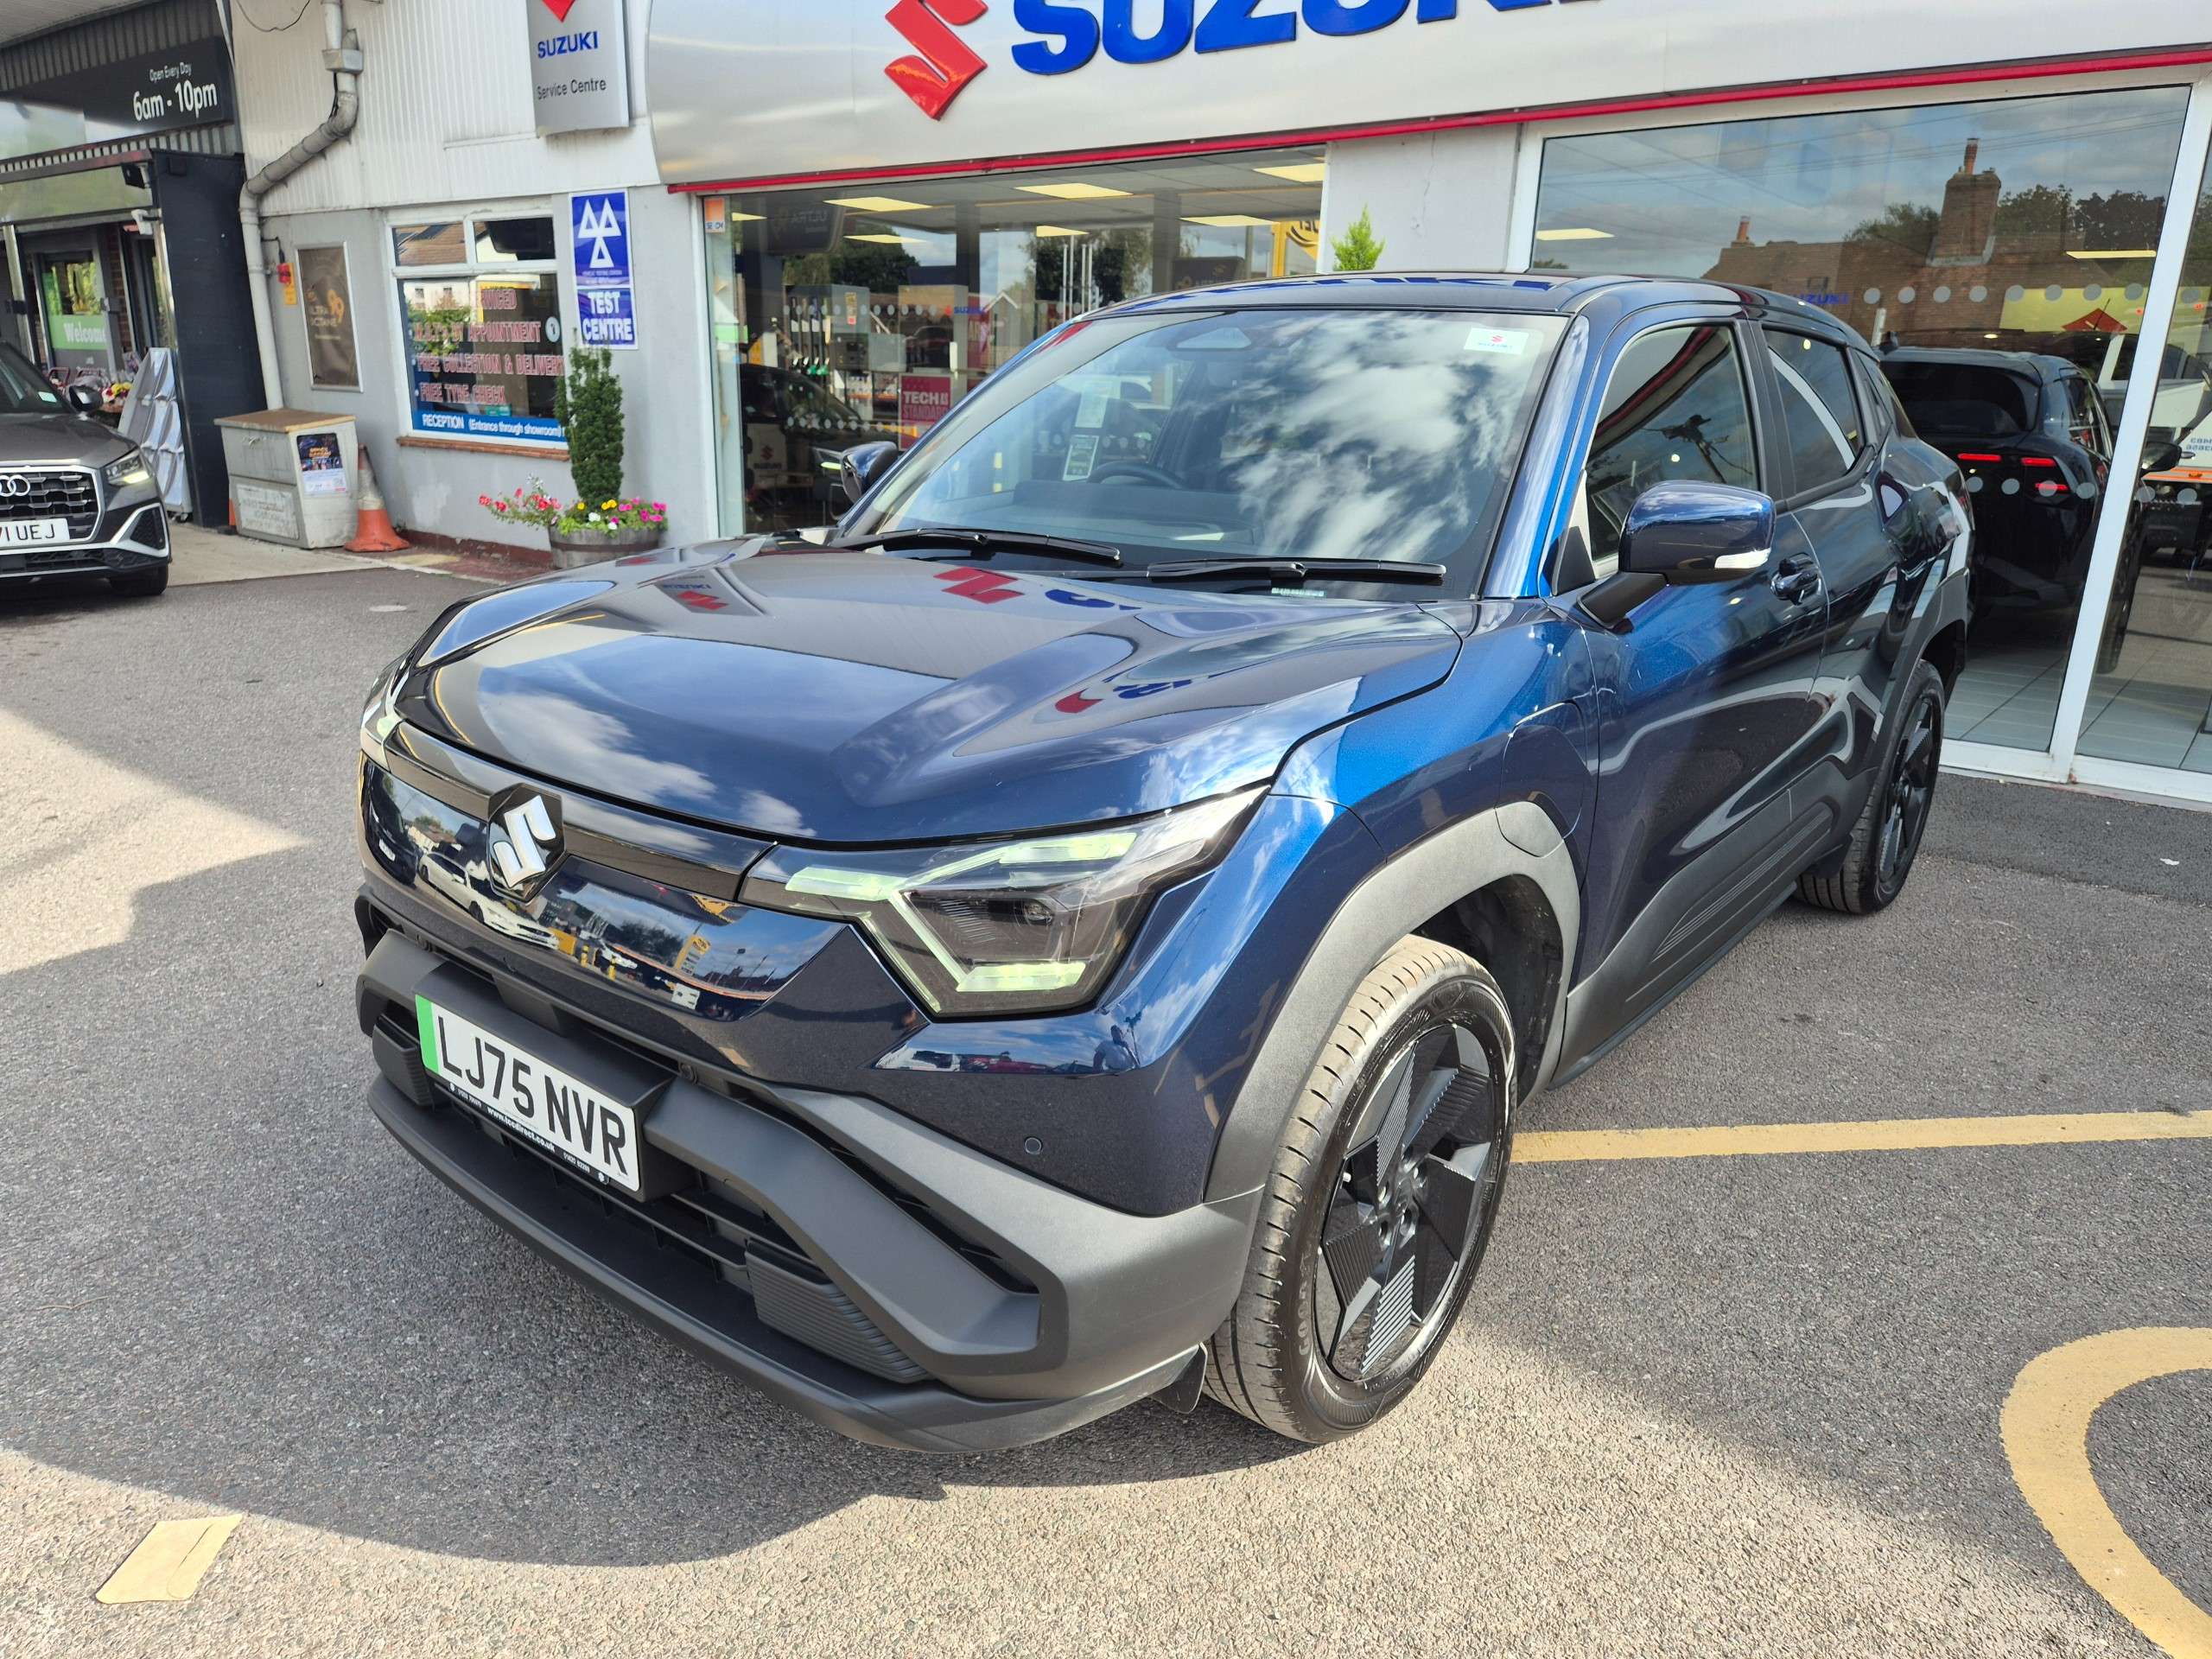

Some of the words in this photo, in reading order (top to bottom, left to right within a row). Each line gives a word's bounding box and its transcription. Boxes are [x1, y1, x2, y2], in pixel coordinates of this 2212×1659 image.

[537, 31, 598, 59] SUZUKI
[1012, 0, 1552, 76] SUZ
[149, 69, 165, 82] Open
[164, 65, 179, 79] Every
[180, 61, 192, 76] Day
[133, 91, 165, 121] 6am
[175, 79, 218, 118] 10pm
[537, 85, 568, 99] Service
[570, 79, 607, 93] Centre
[588, 291, 620, 315] TEST
[468, 321, 542, 342] APPOINTMENT
[582, 318, 632, 340] CENTRE
[418, 353, 441, 372] FREE
[442, 353, 502, 374] COLLECTION
[505, 354, 514, 375] &
[420, 382, 443, 403] FREE
[444, 384, 470, 404] TYRE
[472, 385, 507, 405] CHECK
[903, 391, 939, 404] TECH
[422, 413, 465, 429] RECEPTION
[0, 526, 10, 542] 1
[16, 524, 55, 541] UEJ
[437, 1015, 535, 1119] LJ75
[543, 1074, 629, 1176] NVR
